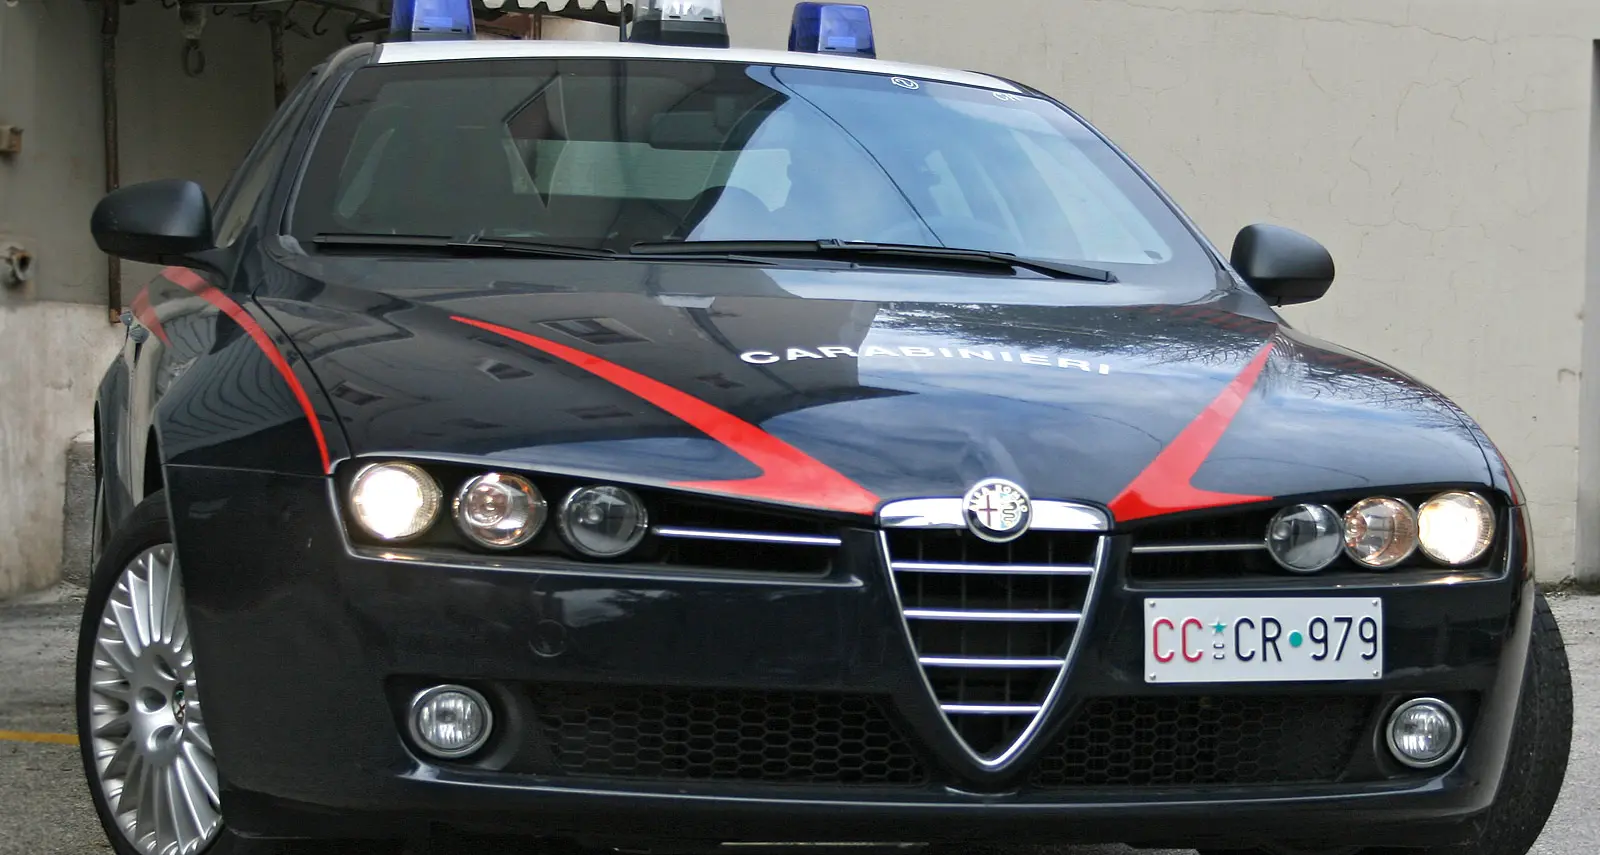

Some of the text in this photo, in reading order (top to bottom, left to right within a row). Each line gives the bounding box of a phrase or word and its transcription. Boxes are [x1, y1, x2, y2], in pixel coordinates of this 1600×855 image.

[740, 345, 1110, 375] CARABINIERI
[1152, 616, 1378, 663] CC CR 979
